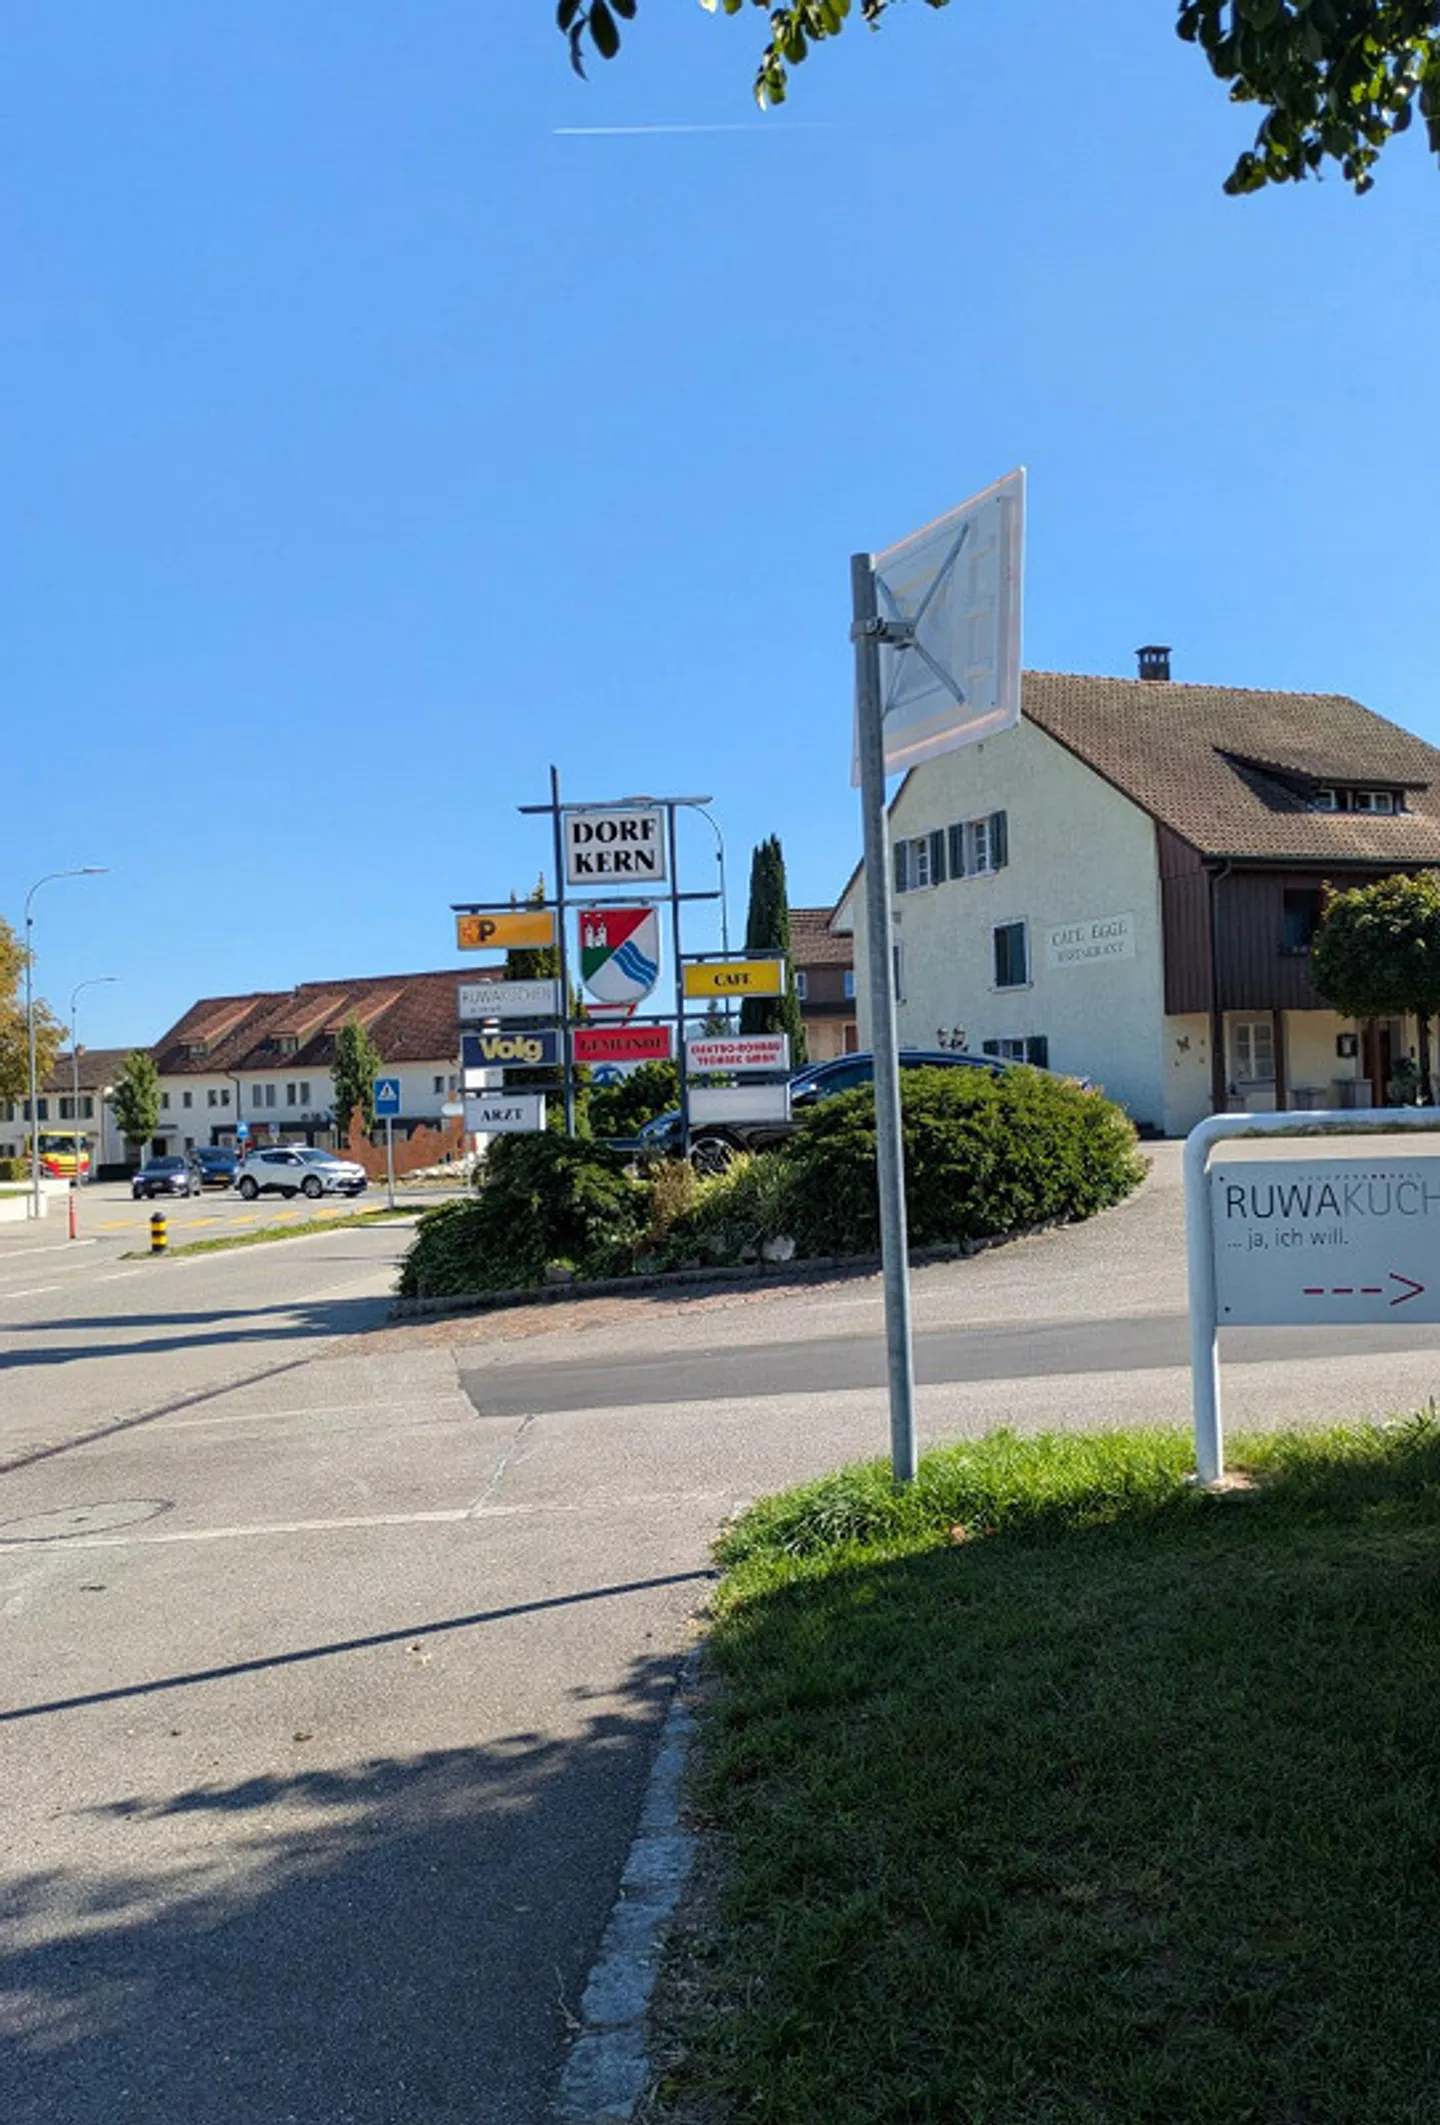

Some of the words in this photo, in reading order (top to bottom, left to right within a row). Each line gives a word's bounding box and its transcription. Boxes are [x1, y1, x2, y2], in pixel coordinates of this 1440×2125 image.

[573, 818, 656, 844] DORF
[575, 849, 655, 873] KERN
[478, 1036, 543, 1063] Volg
[482, 1108, 523, 1122] ARZT
[1248, 1228, 1268, 1250] ja,
[1275, 1227, 1303, 1246] ich
[1310, 1227, 1349, 1245] will.
